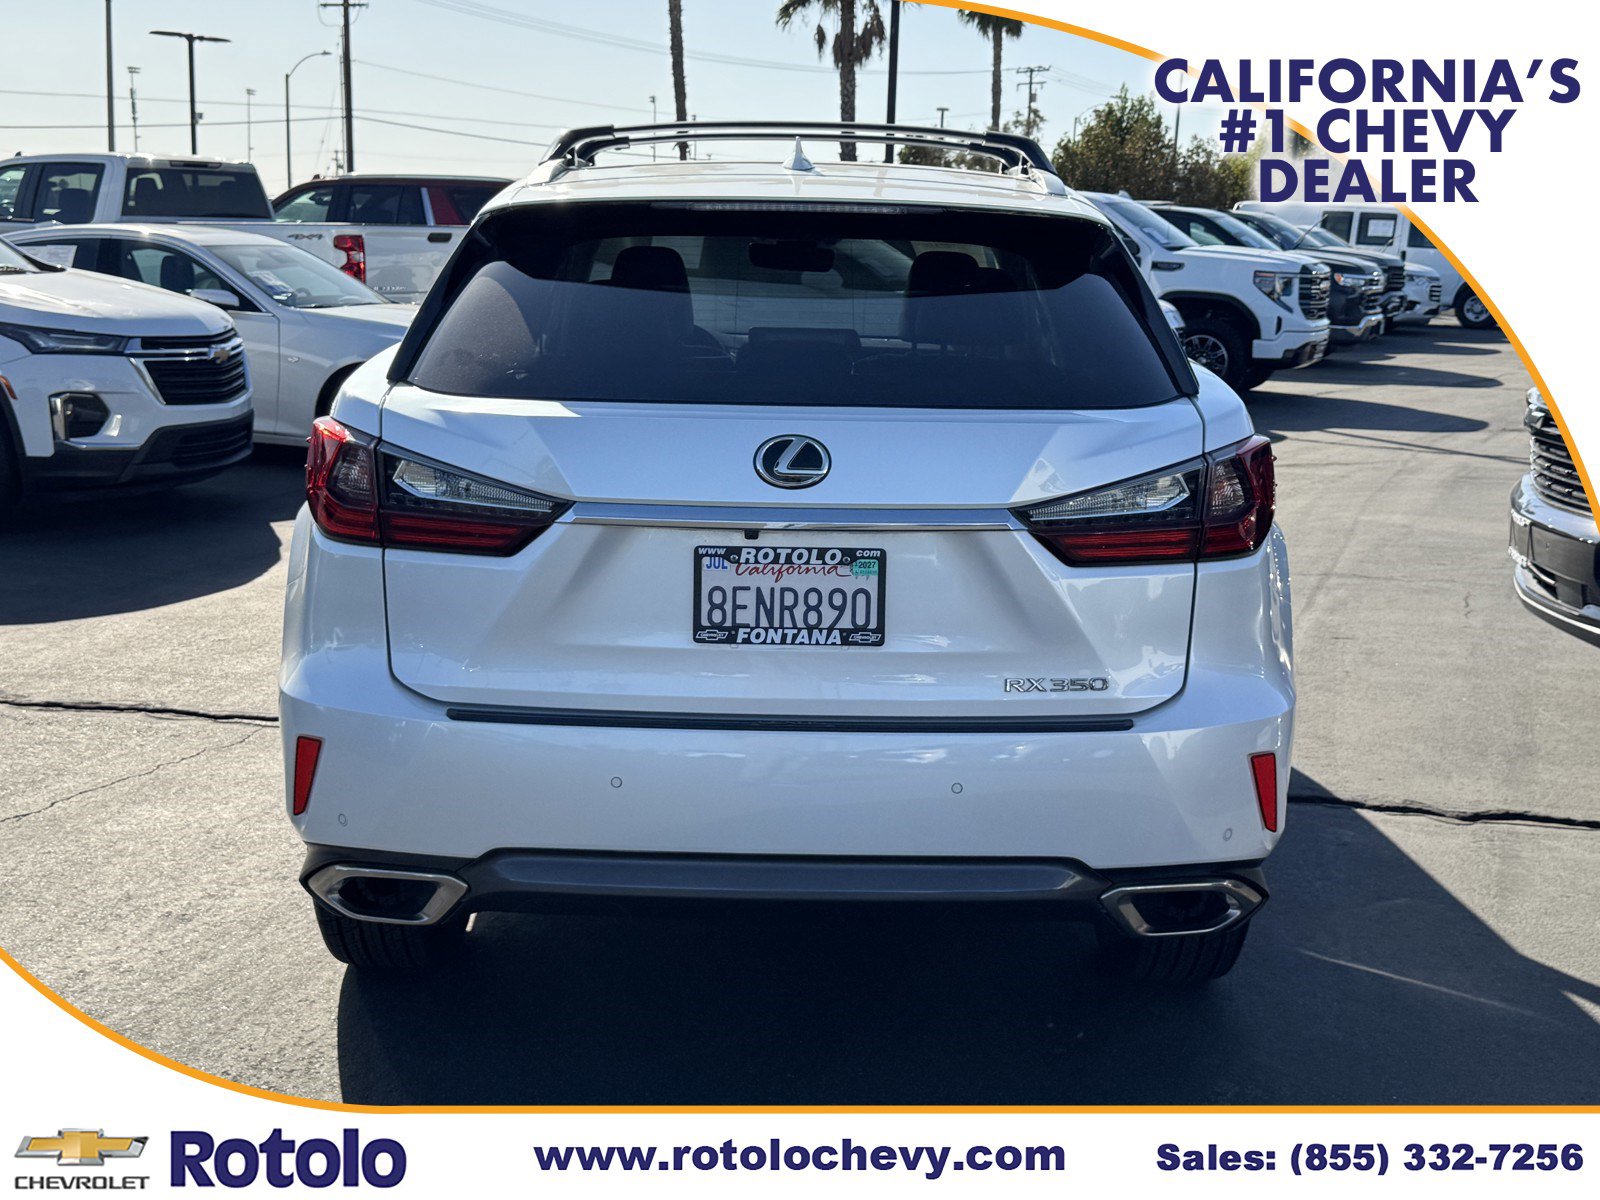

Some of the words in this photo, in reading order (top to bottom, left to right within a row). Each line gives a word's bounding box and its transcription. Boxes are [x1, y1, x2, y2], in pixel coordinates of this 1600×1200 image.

[705, 557, 728, 570] JUL
[739, 548, 842, 564] ROTOLO
[735, 563, 853, 583] California
[858, 561, 876, 569] 2027
[707, 585, 871, 629] 8ENR890
[736, 628, 842, 645] FONTANA
[1004, 678, 1047, 692] RX
[1049, 678, 1109, 692] 350
